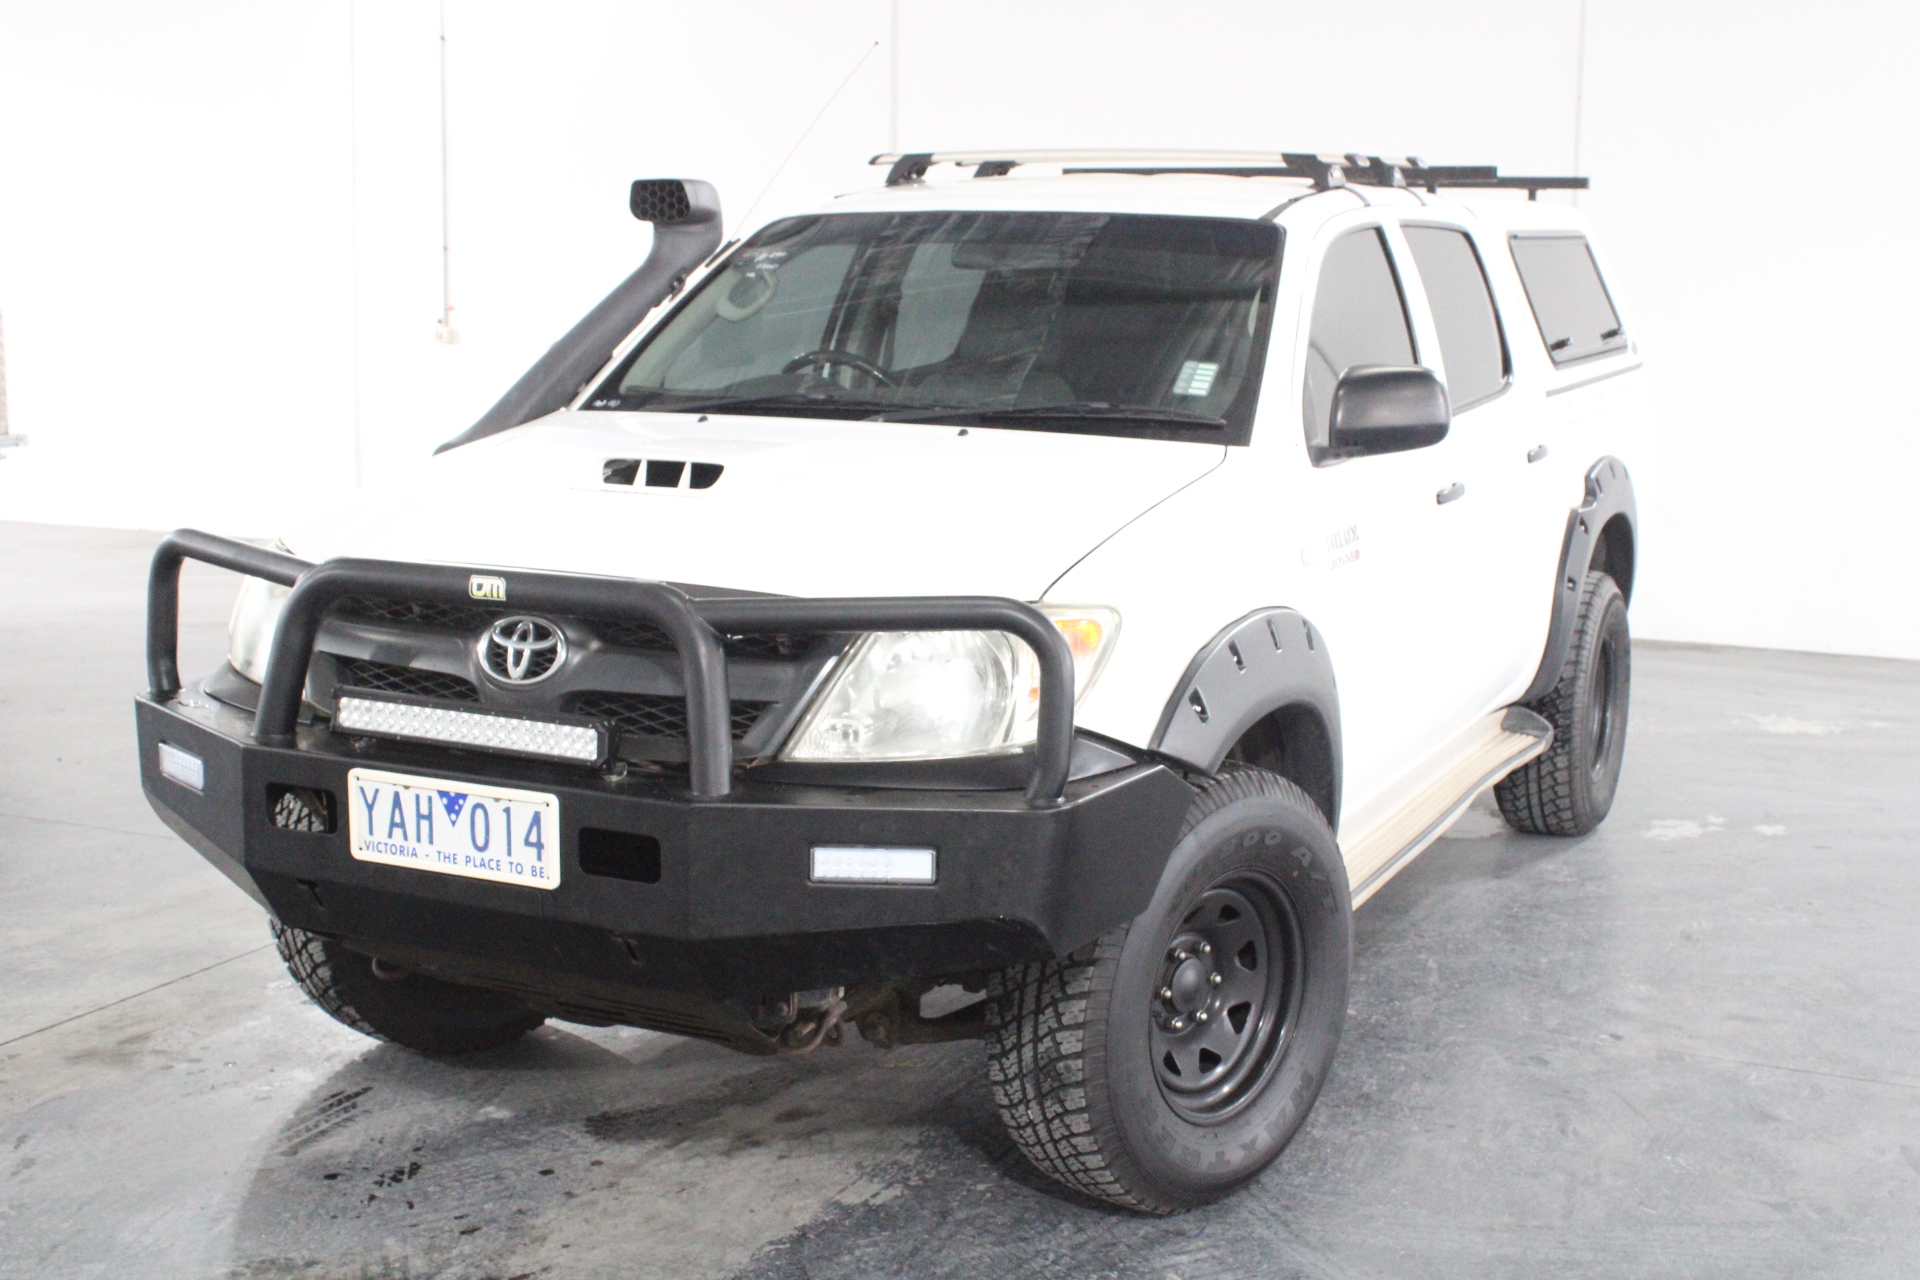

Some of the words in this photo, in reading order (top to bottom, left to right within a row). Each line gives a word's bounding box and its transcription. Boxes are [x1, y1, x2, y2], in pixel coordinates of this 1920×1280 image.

[359, 786, 434, 845] YAH
[470, 802, 545, 862] 014
[364, 840, 418, 858] VICTORIA
[436, 850, 458, 865] THE
[465, 855, 502, 871] PLACE
[509, 861, 523, 875] TO
